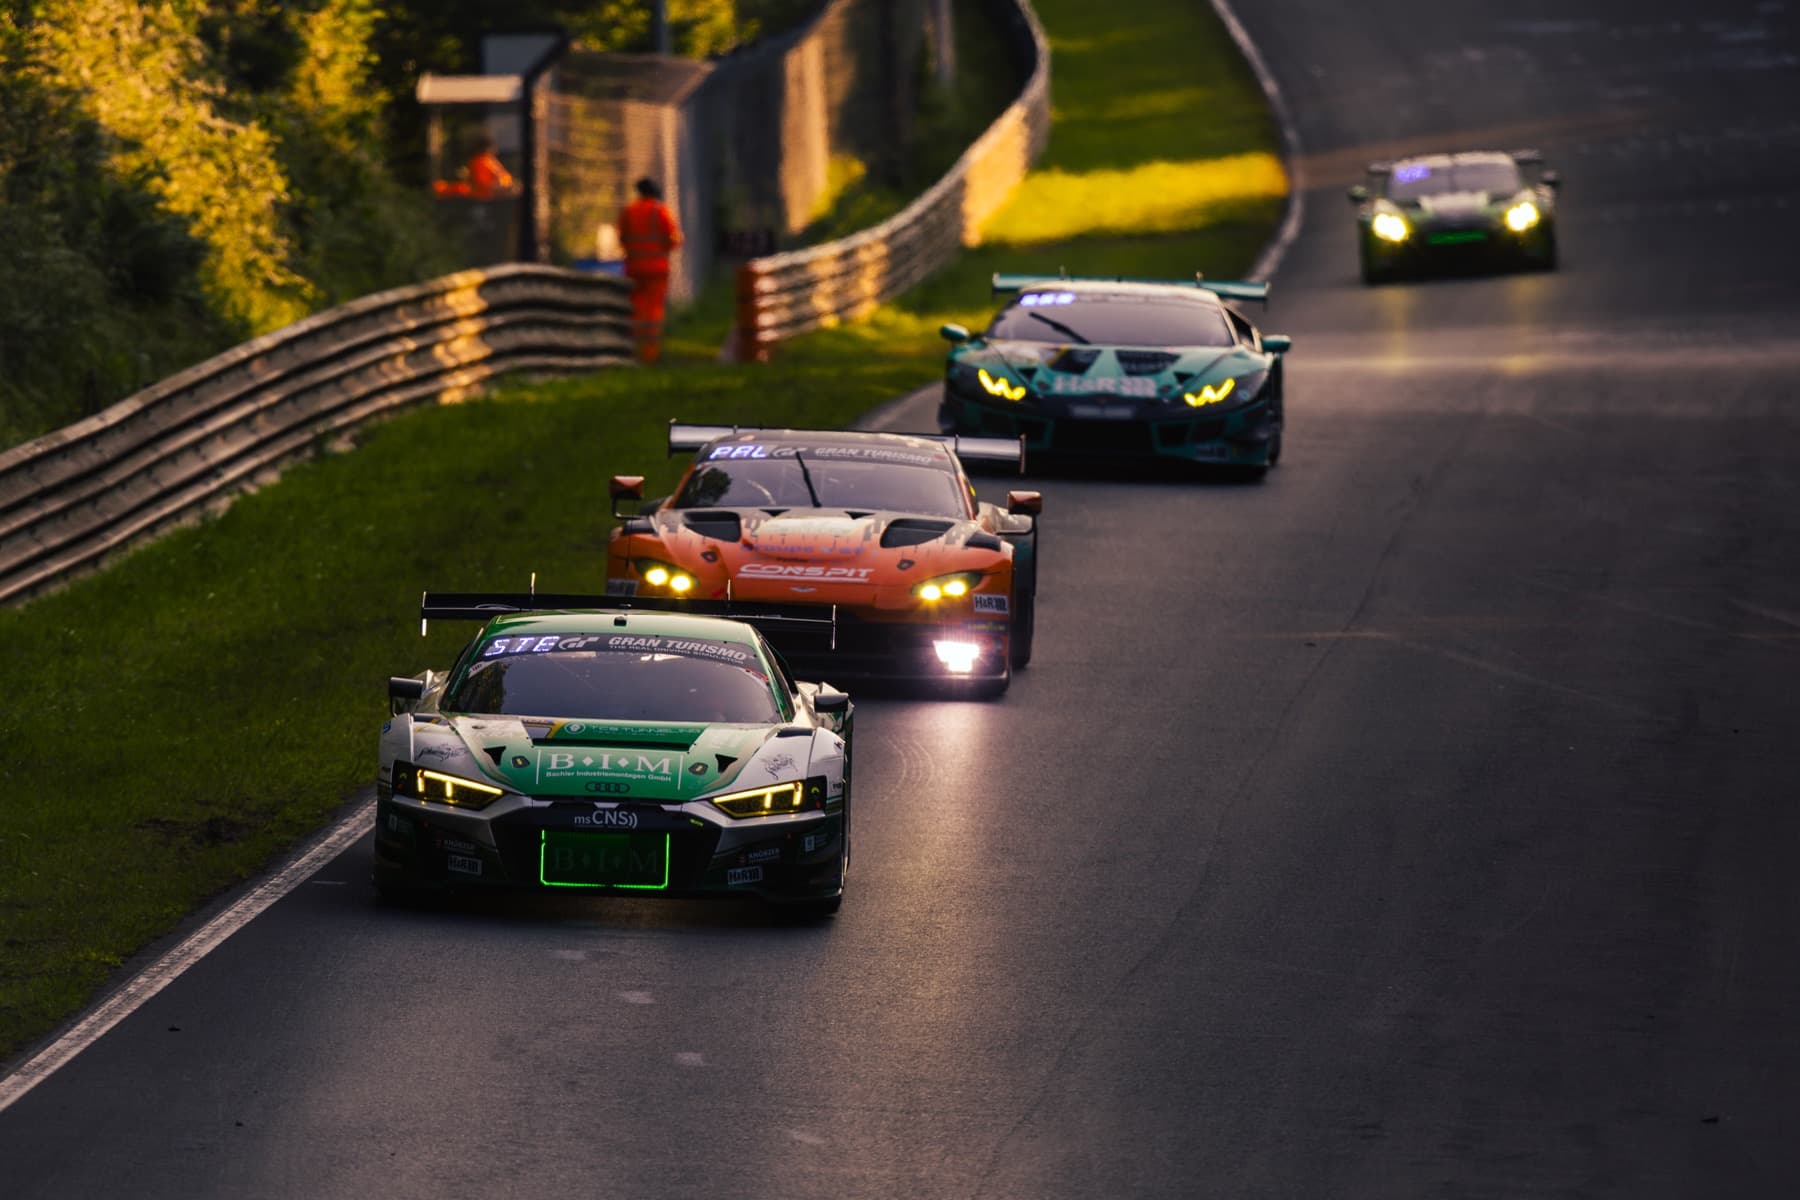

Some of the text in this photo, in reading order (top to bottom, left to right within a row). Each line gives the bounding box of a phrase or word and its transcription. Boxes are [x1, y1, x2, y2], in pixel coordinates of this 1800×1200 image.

[709, 445, 766, 460] PAL
[814, 447, 859, 457] GRAN
[862, 448, 932, 464] TURISMO
[608, 636, 662, 648] GRAN
[665, 639, 747, 661] TURISMO
[647, 773, 672, 782] GmbH
